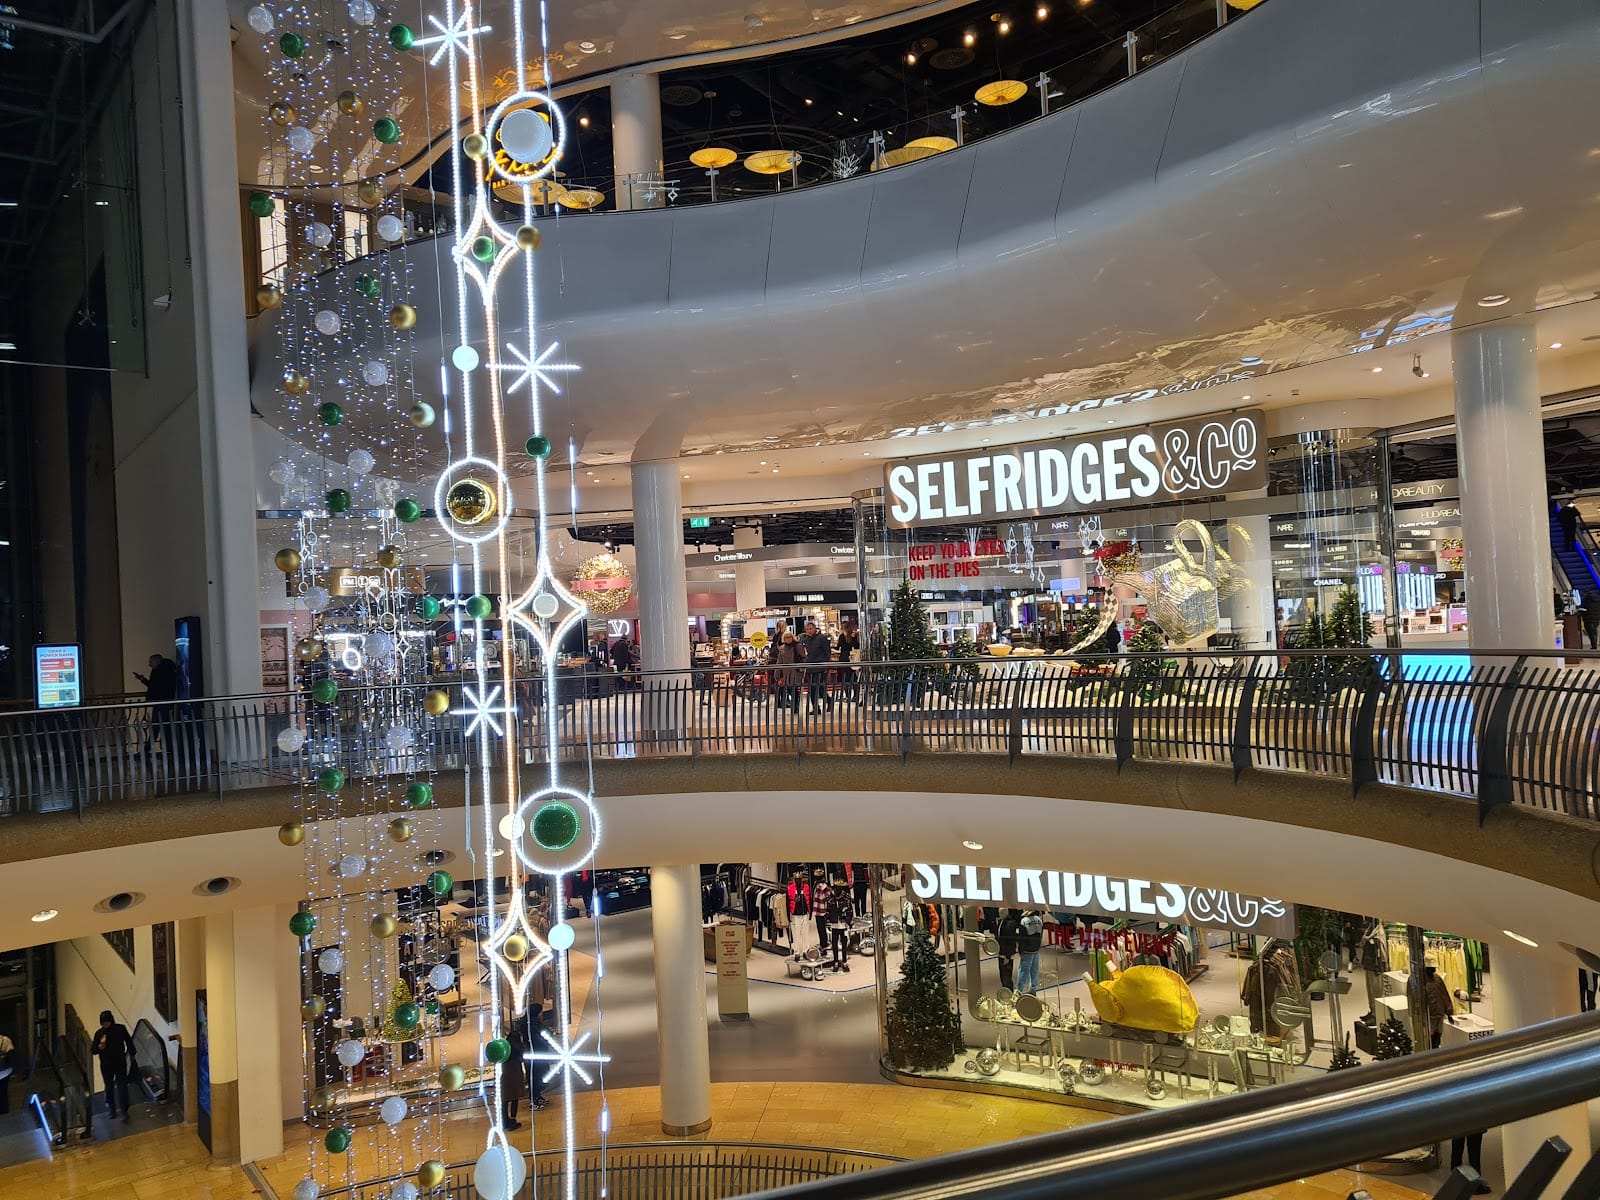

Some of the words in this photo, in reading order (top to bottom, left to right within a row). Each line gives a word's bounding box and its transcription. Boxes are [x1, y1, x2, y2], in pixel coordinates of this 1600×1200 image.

[1370, 484, 1445, 499] HDABEAUTY
[908, 544, 936, 562] KEEP
[975, 539, 1005, 556] EYES
[909, 565, 926, 581] ON
[930, 563, 951, 579] THE
[954, 561, 980, 578] PIES
[1313, 578, 1343, 586] CHANEL
[1045, 924, 1075, 947] THE
